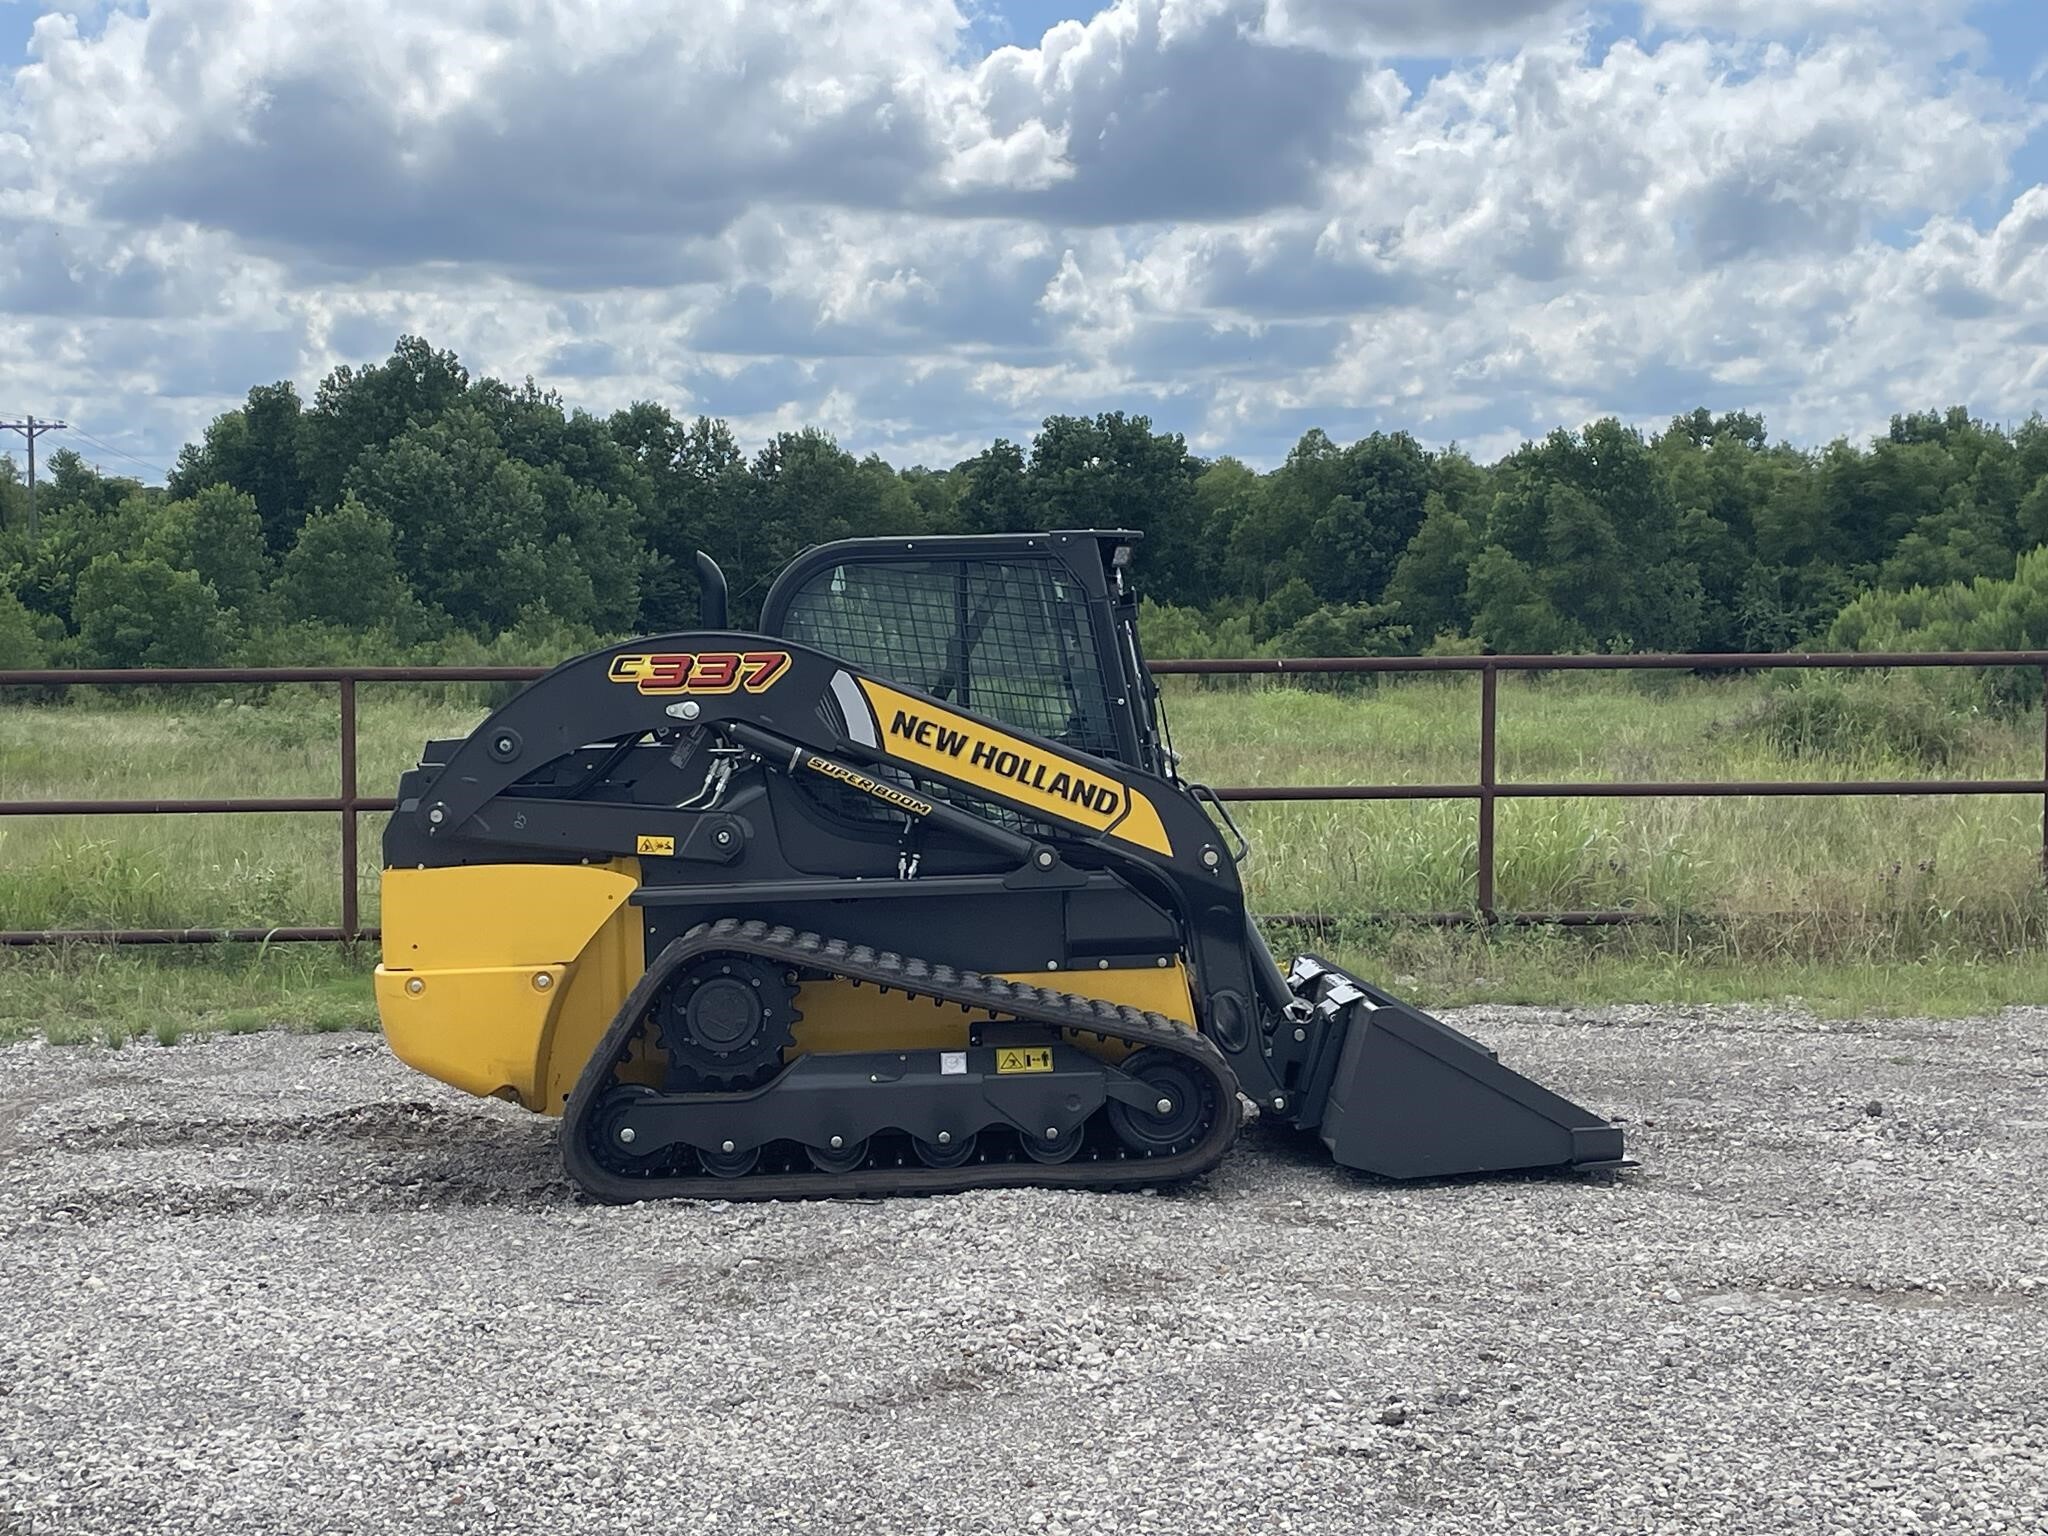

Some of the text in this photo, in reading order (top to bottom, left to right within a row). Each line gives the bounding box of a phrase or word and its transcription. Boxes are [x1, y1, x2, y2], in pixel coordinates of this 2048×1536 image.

[610, 654, 790, 691] C337
[809, 758, 931, 814] SUPER BOOM
[890, 710, 1119, 815] NEW HOLLAND
